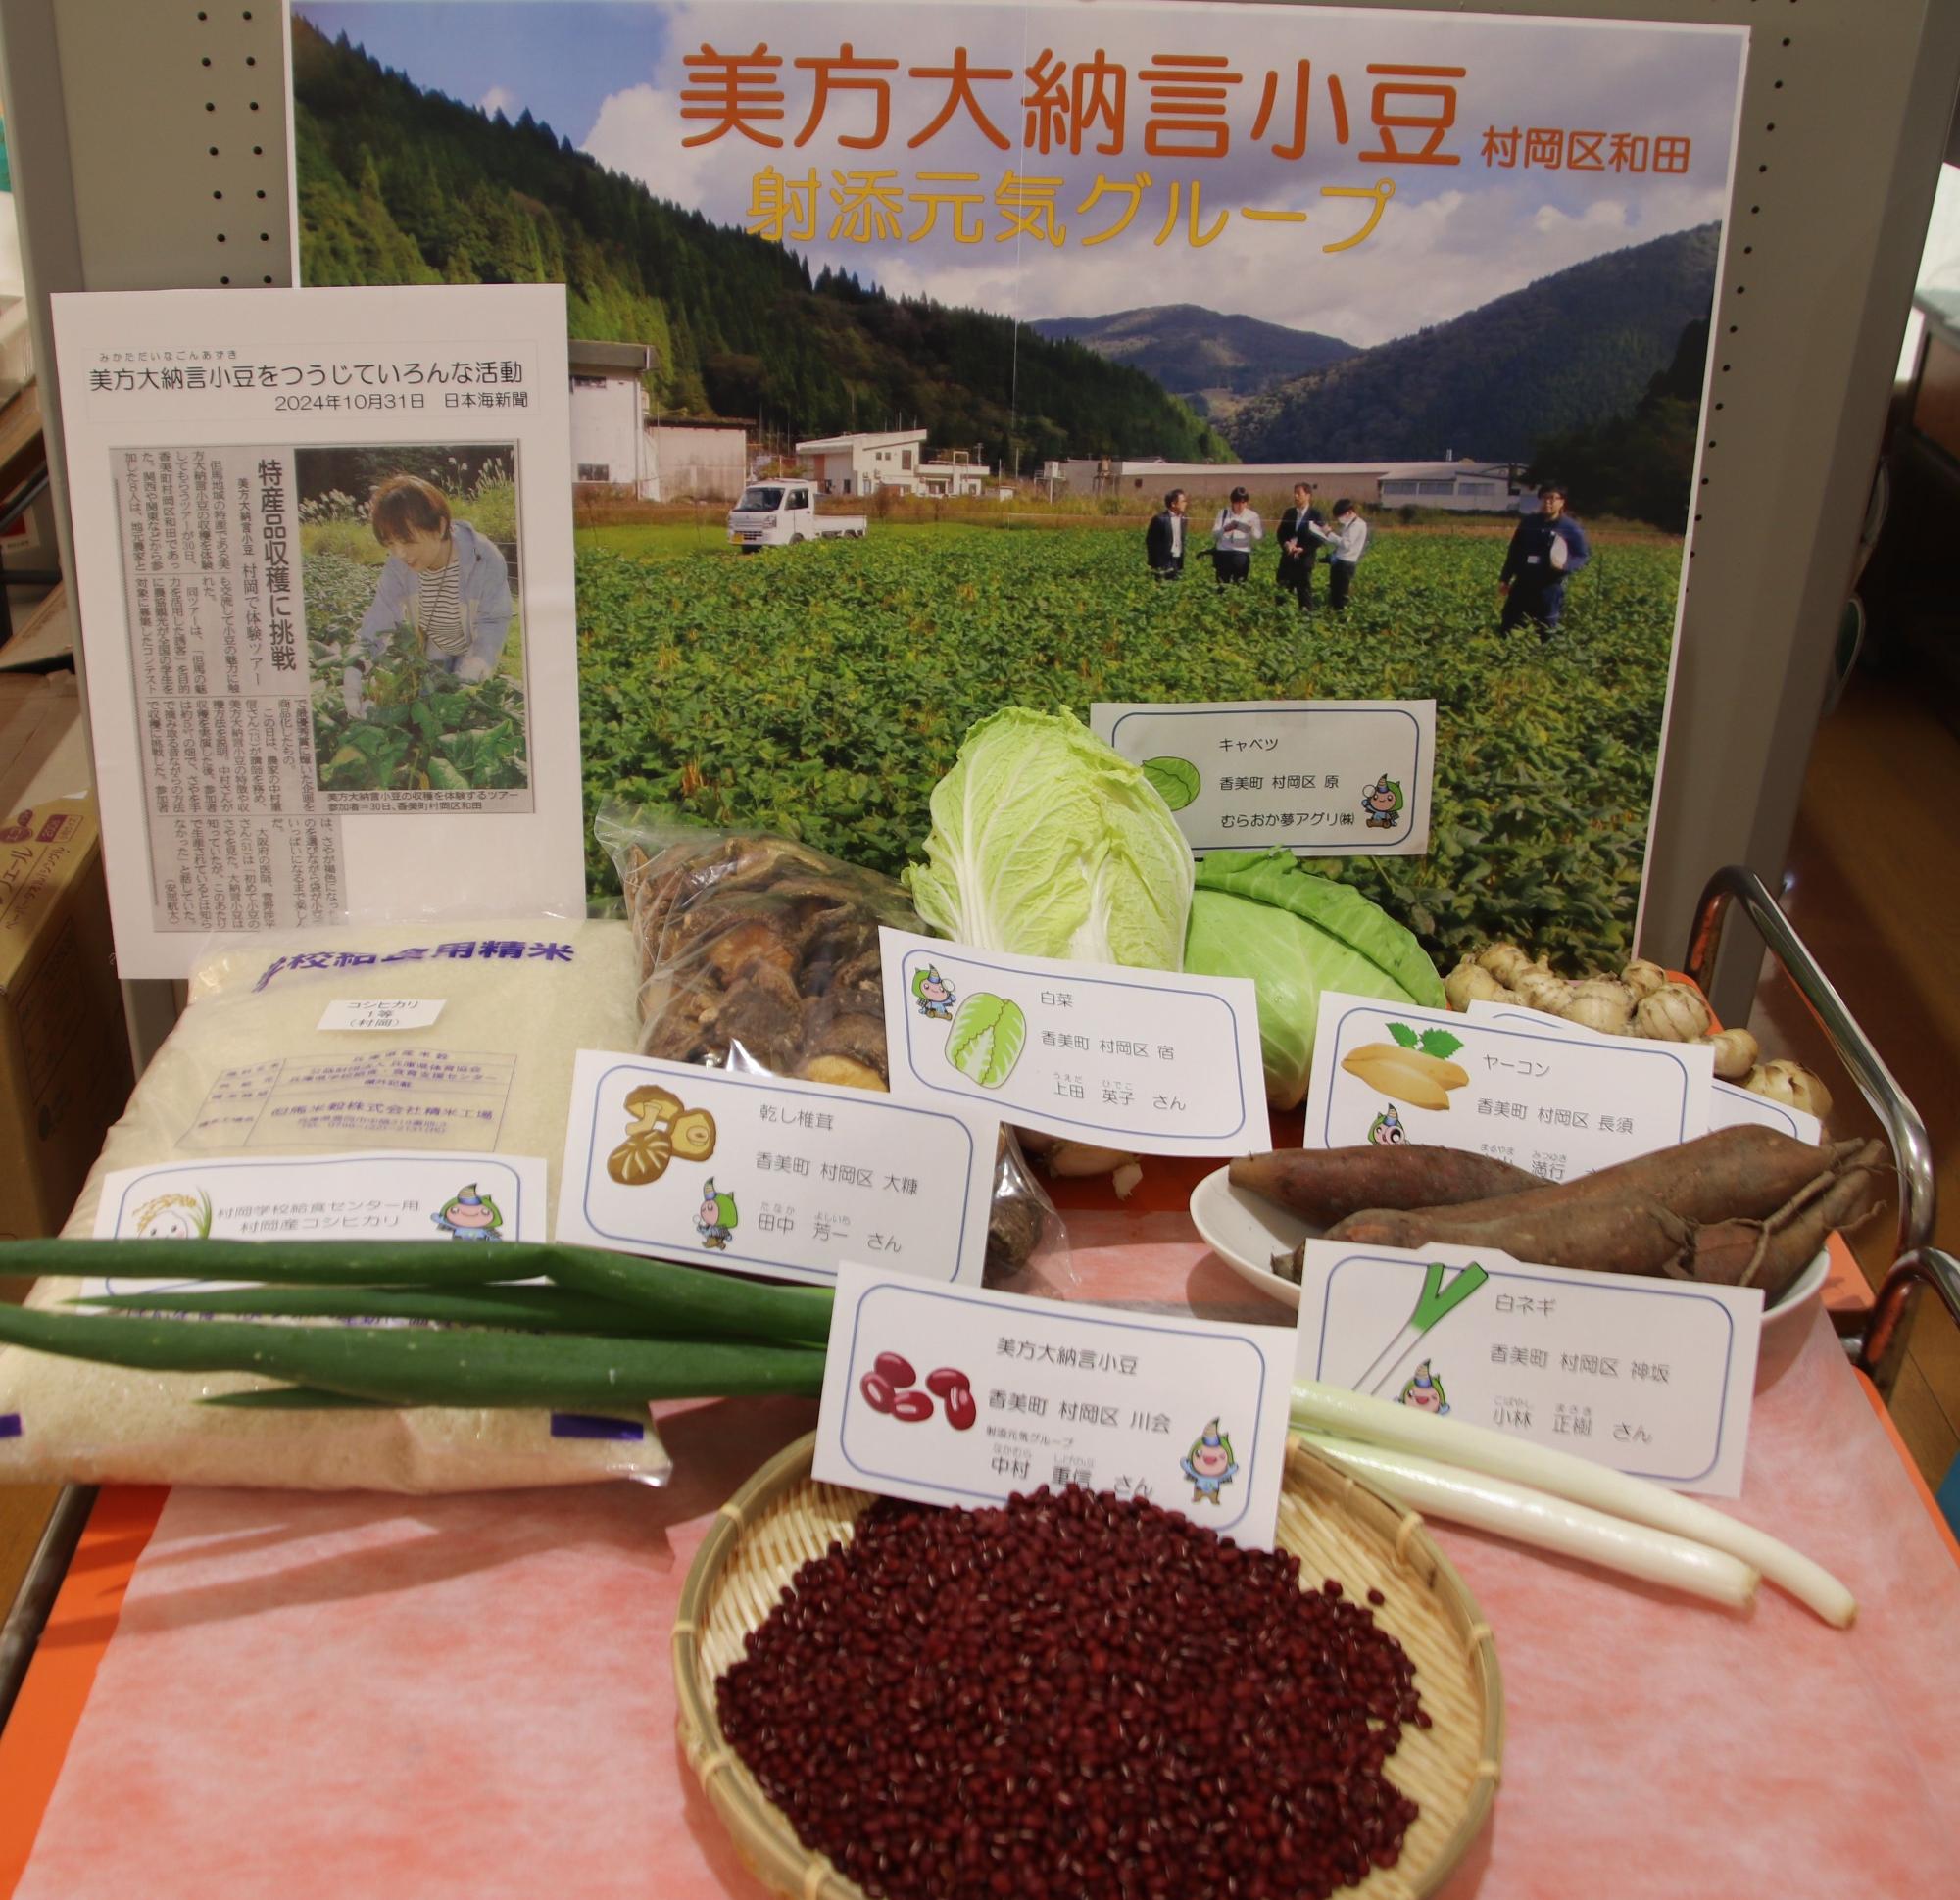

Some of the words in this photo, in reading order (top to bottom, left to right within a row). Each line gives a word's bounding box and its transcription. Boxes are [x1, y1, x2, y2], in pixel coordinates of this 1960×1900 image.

[679, 41, 1467, 166] 美方大納言小豆
[1480, 124, 1691, 174] 村岡区和田
[746, 165, 1396, 253] 射添元気グループ
[89, 360, 523, 392] 美方大納言小豆をつうじていろんな活動
[274, 392, 425, 412] 2024年10月31日
[444, 391, 528, 410] 日本海新聞
[236, 477, 254, 557] 美方大納言小豆
[258, 459, 296, 671] 特産品収穫に挑戦
[242, 563, 263, 686] 村岡で体験ツアー
[1219, 737, 1279, 753] キャベツ
[1219, 775, 1264, 792] 香美町
[1272, 774, 1316, 790] 村岡区
[1324, 774, 1340, 790] 原
[346, 999, 419, 1010] コシヒカリ
[1041, 990, 1074, 1008] 白菜
[1041, 1030, 1091, 1051] 香美町
[1099, 1039, 1149, 1058] 村岡区
[1157, 1044, 1175, 1061] 宿
[1483, 1053, 1551, 1078] ヤーコン
[1054, 1081, 1085, 1100] 上田
[1102, 1088, 1135, 1106] 英子
[1152, 1095, 1187, 1112] さん
[760, 1103, 835, 1131] 乾し椎茸
[1477, 1097, 1528, 1120] 香美町
[1537, 1106, 1590, 1129] 村岡区
[1598, 1115, 1635, 1135] 長須
[756, 1150, 811, 1177] 香美町
[820, 1162, 875, 1188] 村岡区
[218, 1199, 421, 1219] 村岡学校給食センター用
[240, 1214, 400, 1235] 村岡産コシヒカリ
[758, 1212, 795, 1236] 田中
[812, 1221, 849, 1242] 芳一
[866, 1232, 903, 1254] さん
[1494, 1292, 1556, 1317] 白ネギ
[996, 1336, 1139, 1375] 美方大納言小豆
[1490, 1343, 1550, 1369] 香美町
[1559, 1351, 1620, 1378] 村岡区
[988, 1388, 1049, 1417] 香美町
[1058, 1400, 1120, 1428] 村岡区
[1130, 1410, 1172, 1435] 川会
[1493, 1408, 1532, 1429] 小林
[1613, 1422, 1653, 1445] さん
[990, 1456, 1030, 1480] 中村
[1113, 1474, 1153, 1497] さん
